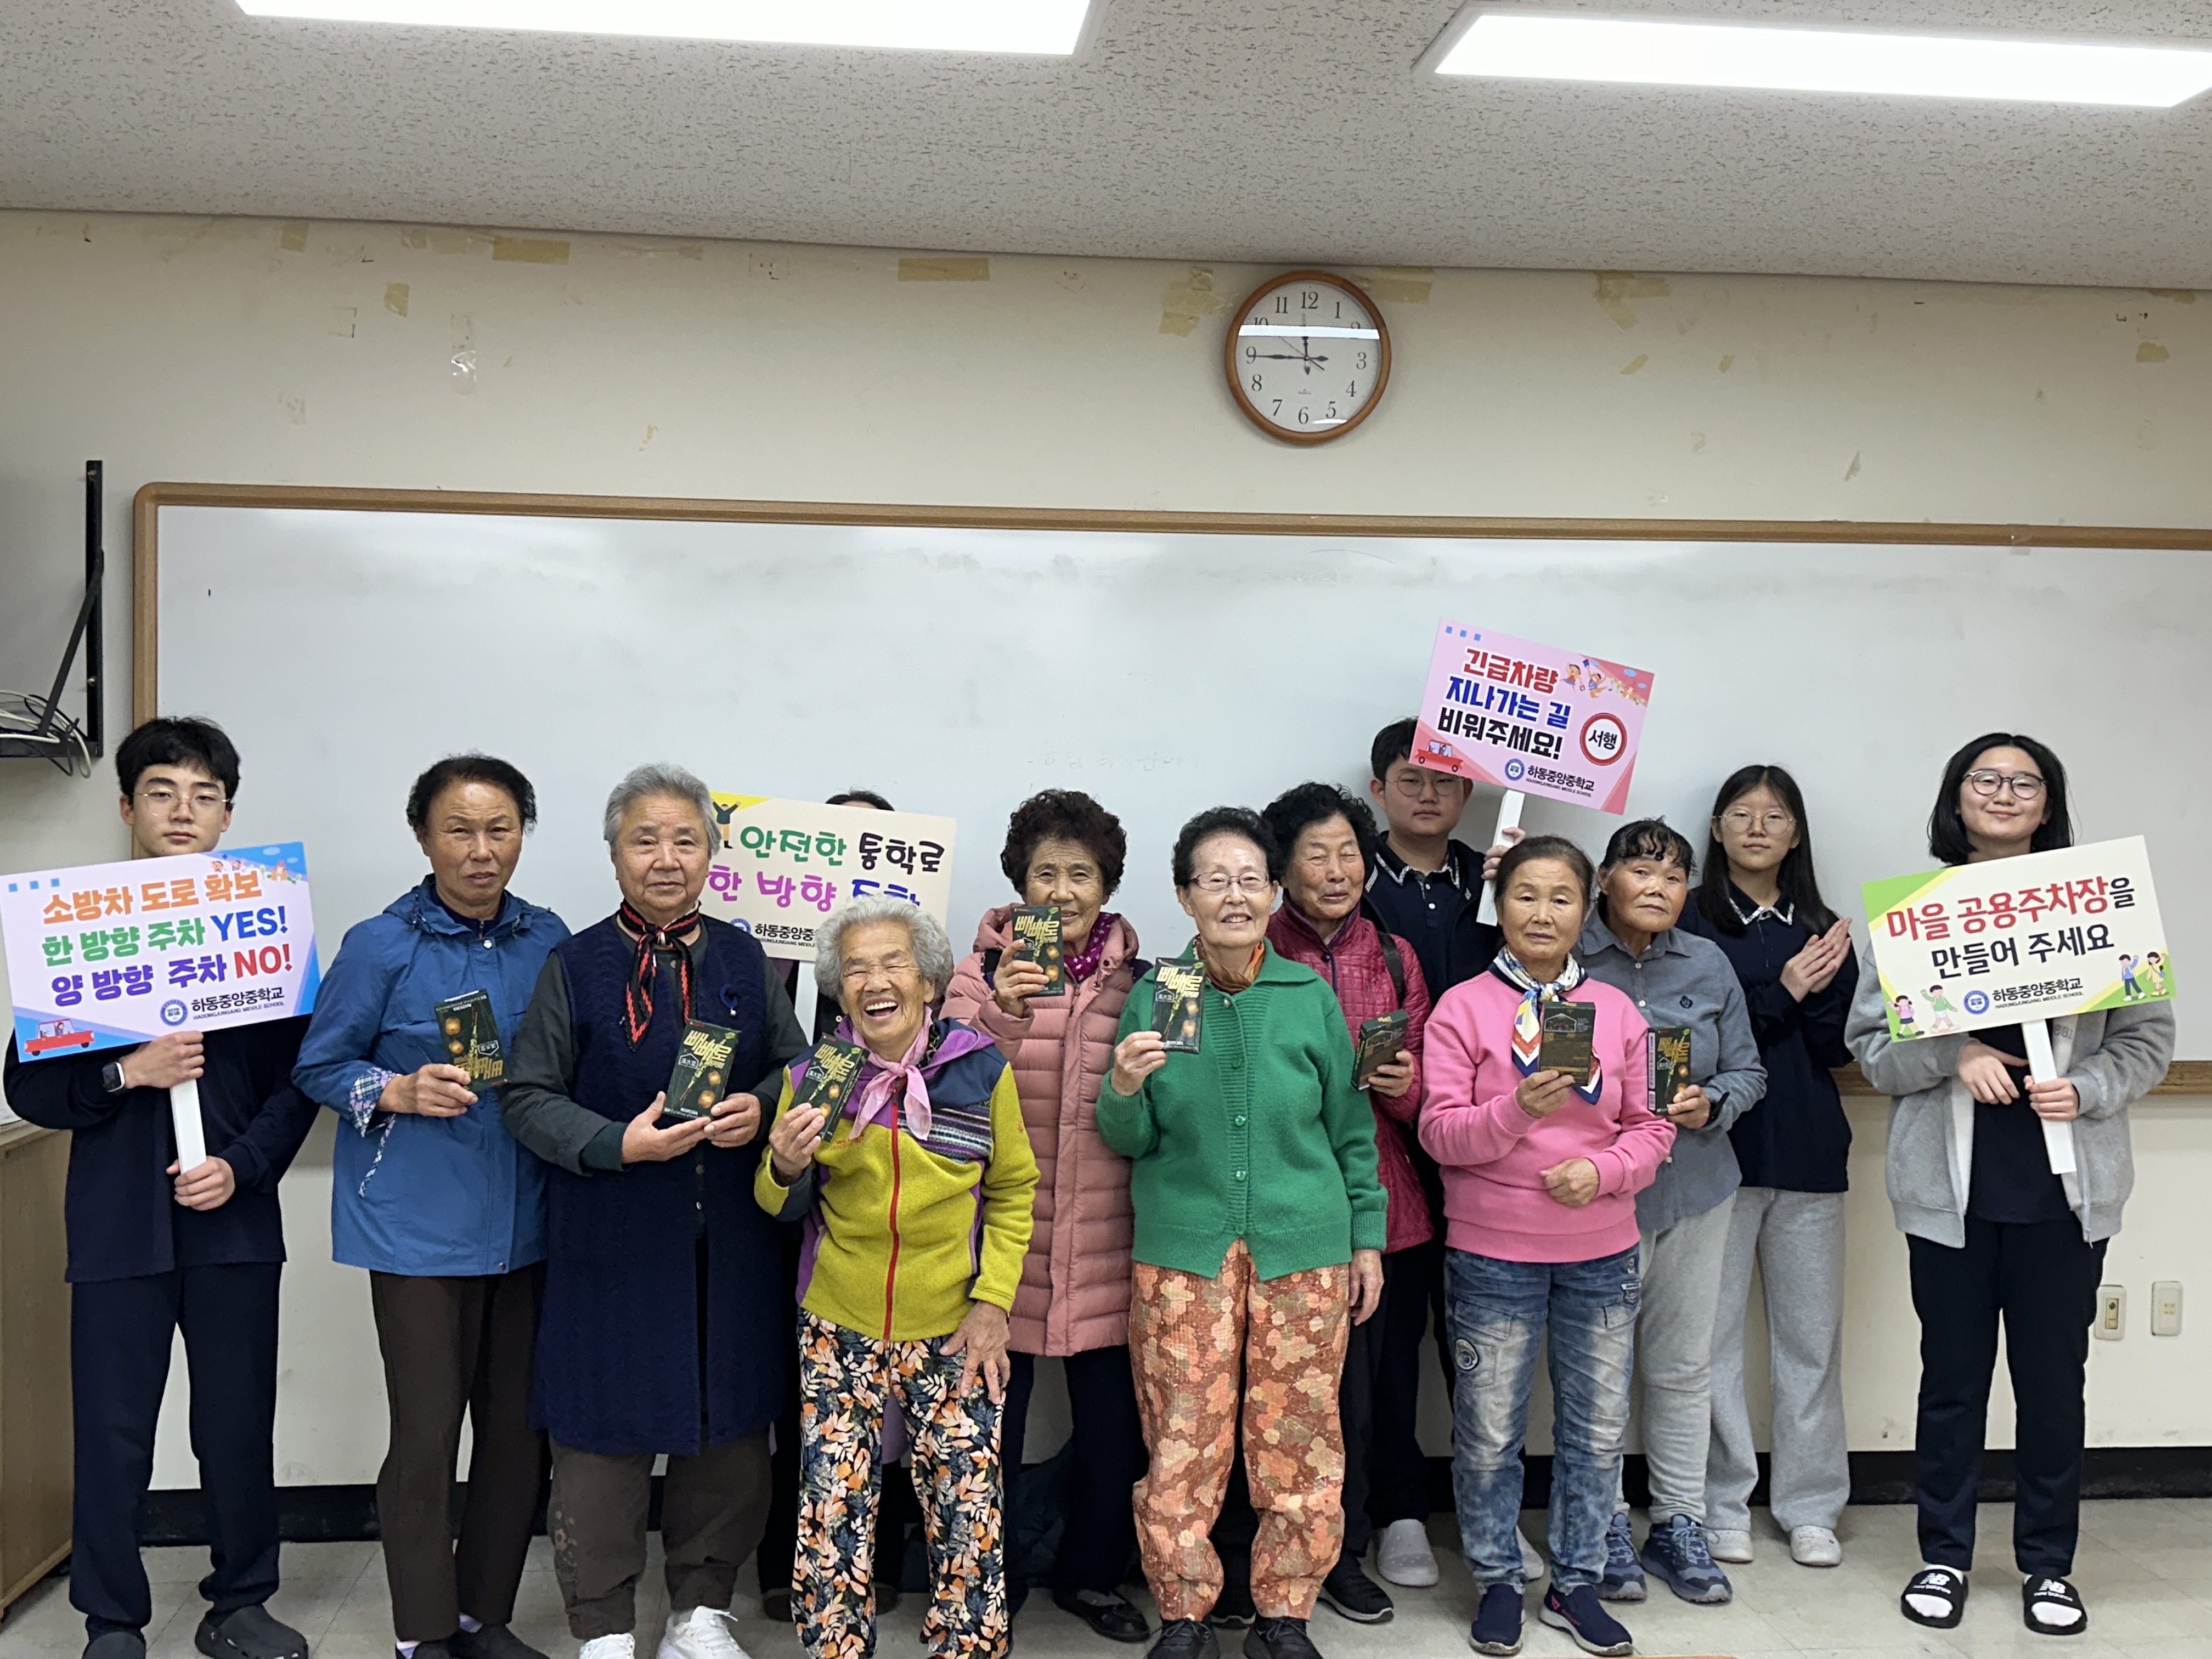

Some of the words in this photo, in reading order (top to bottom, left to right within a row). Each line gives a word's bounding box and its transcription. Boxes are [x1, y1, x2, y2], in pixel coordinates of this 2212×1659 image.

[1275, 297, 1288, 313] 11
[1301, 291, 1318, 309] 12
[1335, 302, 1341, 318] 1
[1246, 346, 1256, 364] 9
[1356, 352, 1367, 369] 3
[1251, 374, 1262, 391] 8
[1346, 380, 1356, 397] 4
[1272, 399, 1282, 416] 7
[1298, 407, 1309, 424] 6
[1325, 401, 1336, 419] 5
[1463, 648, 1560, 694] 긴급차량
[1446, 676, 1539, 722] 지나가는
[1545, 701, 1572, 730] 길
[1437, 707, 1564, 760] 비워주세요!
[1588, 730, 1617, 750] 서행
[1527, 765, 1594, 792] 하동중앙중학교
[740, 826, 847, 866] 안전한
[859, 832, 945, 874] 통학로
[43, 886, 133, 924] 소방차
[141, 878, 199, 911] 도로
[205, 870, 262, 902] 확보
[708, 865, 742, 901] 한
[757, 871, 837, 912] 방향
[1887, 902, 1950, 941] 마을
[1957, 876, 2135, 933] 공용주차장을
[42, 936, 73, 967] 한
[81, 926, 140, 962] 방향
[148, 918, 205, 951] 주차
[210, 906, 288, 941] YES!
[755, 923, 816, 941] 하동중앙중
[1931, 938, 2019, 980] 만들어
[2028, 923, 2114, 964] 주세요
[52, 975, 83, 1007] 양
[92, 964, 154, 1001] 방향
[168, 955, 227, 988] 주차
[234, 944, 292, 979] NO!
[1156, 967, 1203, 994] 빼빼로
[191, 987, 284, 1013] 하동중앙중학교
[1992, 978, 2083, 1002] 하동중앙중학교
[263, 1001, 284, 1009] SCHOOL
[684, 1030, 732, 1062] 빼빼로
